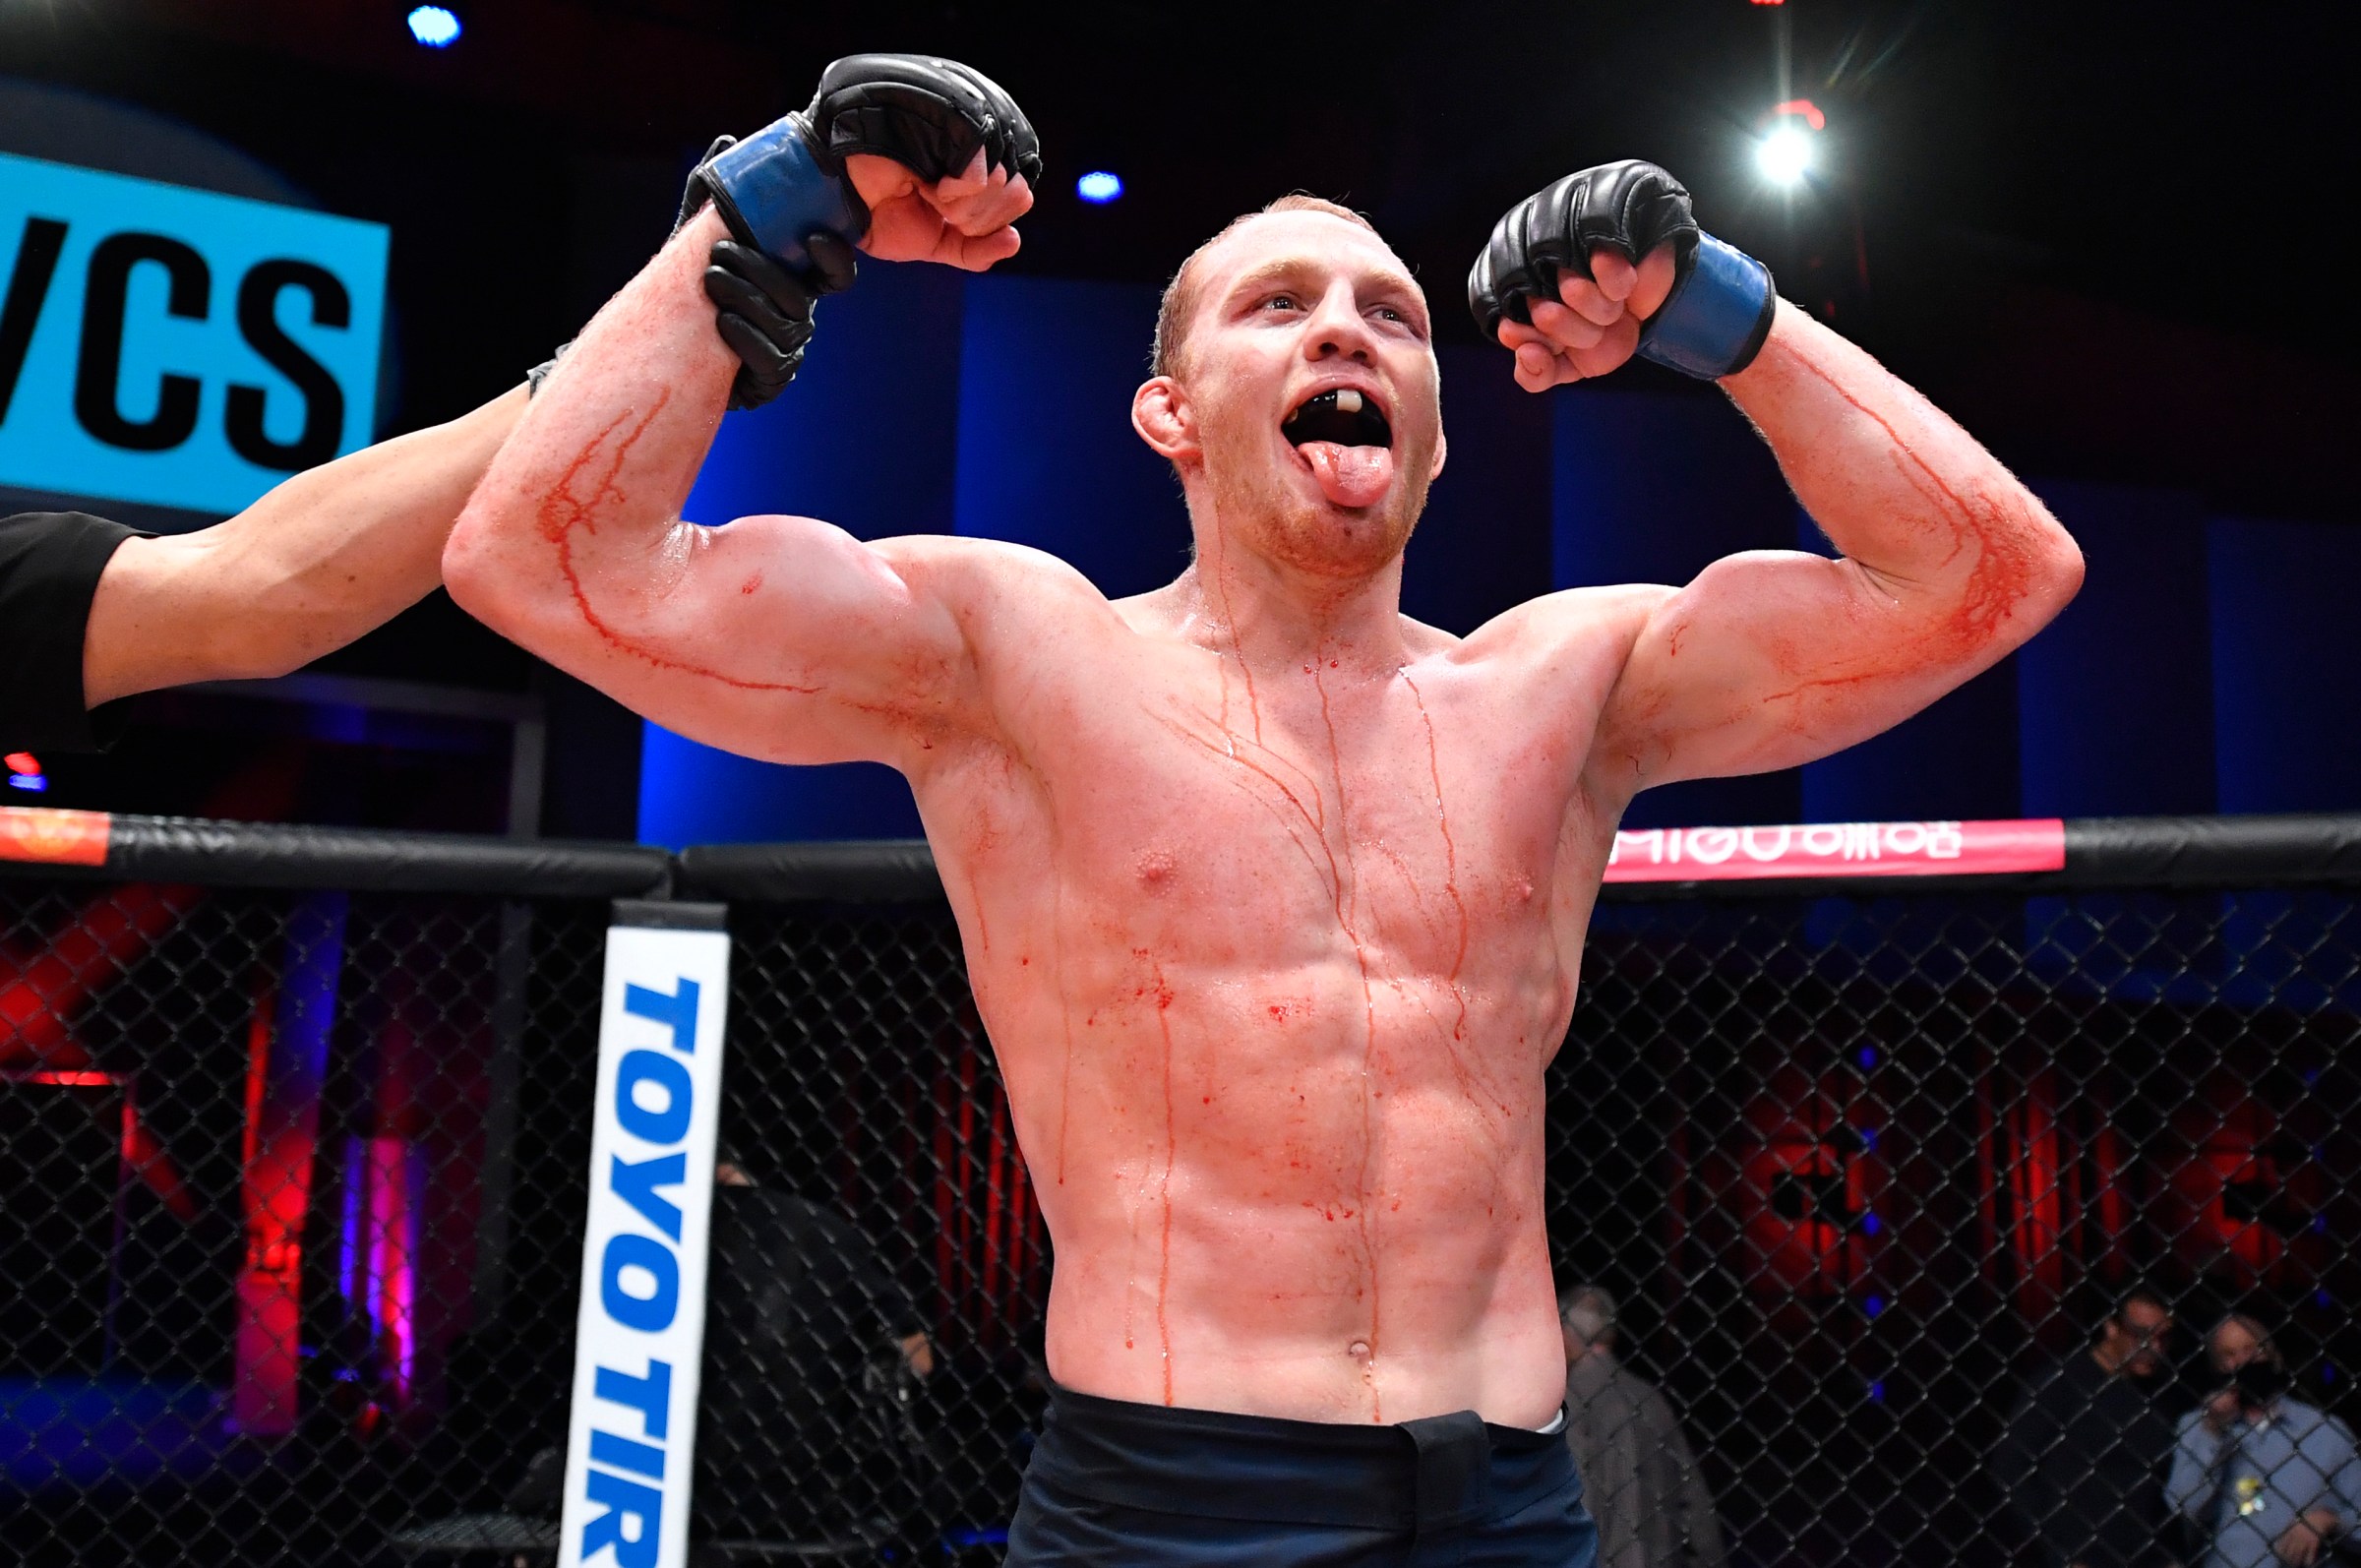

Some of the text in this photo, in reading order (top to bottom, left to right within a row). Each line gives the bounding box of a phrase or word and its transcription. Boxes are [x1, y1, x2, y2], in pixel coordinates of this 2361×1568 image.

[1608, 826, 1791, 865] MIGU
[580, 977, 700, 1568] TOYO TIR
